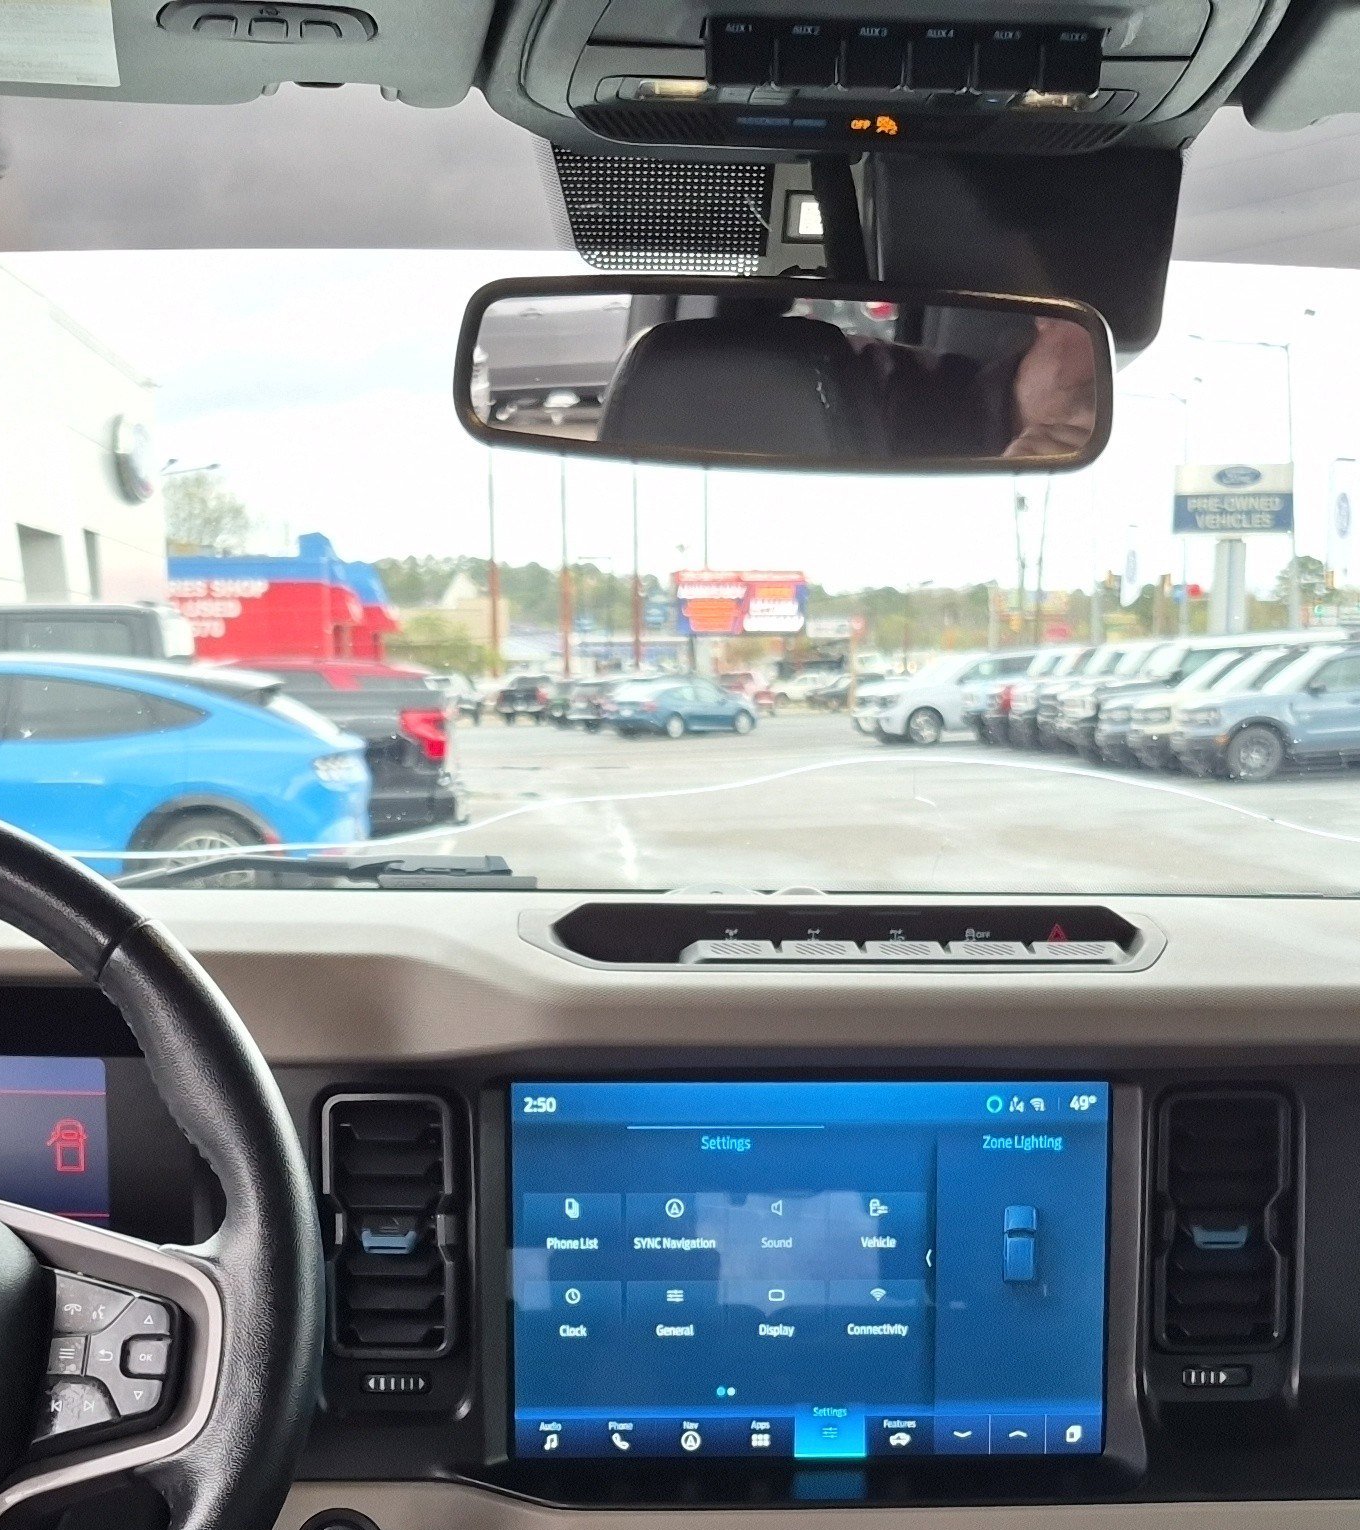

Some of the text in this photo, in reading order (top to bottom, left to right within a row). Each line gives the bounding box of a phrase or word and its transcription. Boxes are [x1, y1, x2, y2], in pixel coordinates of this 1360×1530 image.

[726, 23, 745, 33] AUX
[793, 25, 812, 35] AUX
[860, 27, 879, 37] AUX
[926, 28, 945, 38] AUX
[993, 30, 1012, 39] AUX
[1060, 32, 1078, 41] AUX
[1195, 512, 1275, 528] VEHICLES
[524, 1097, 556, 1113] 2:50
[701, 1135, 751, 1152] Settings
[982, 1134, 1062, 1151] Zone Lighting
[546, 1237, 598, 1250] Phone List
[633, 1237, 716, 1251] SYNC Navigation
[761, 1236, 792, 1249] Sound
[861, 1236, 896, 1249] Vehicle
[559, 1324, 587, 1338] Clock
[656, 1324, 694, 1337] General
[758, 1323, 794, 1339] Display
[847, 1323, 908, 1338] Connectivity
[139, 1353, 153, 1362] OK
[813, 1407, 847, 1417] Settings
[539, 1421, 562, 1431] Audio
[608, 1421, 633, 1431] Phone
[683, 1421, 699, 1430] Nav
[750, 1420, 770, 1431] Apps
[883, 1419, 917, 1428] Features
